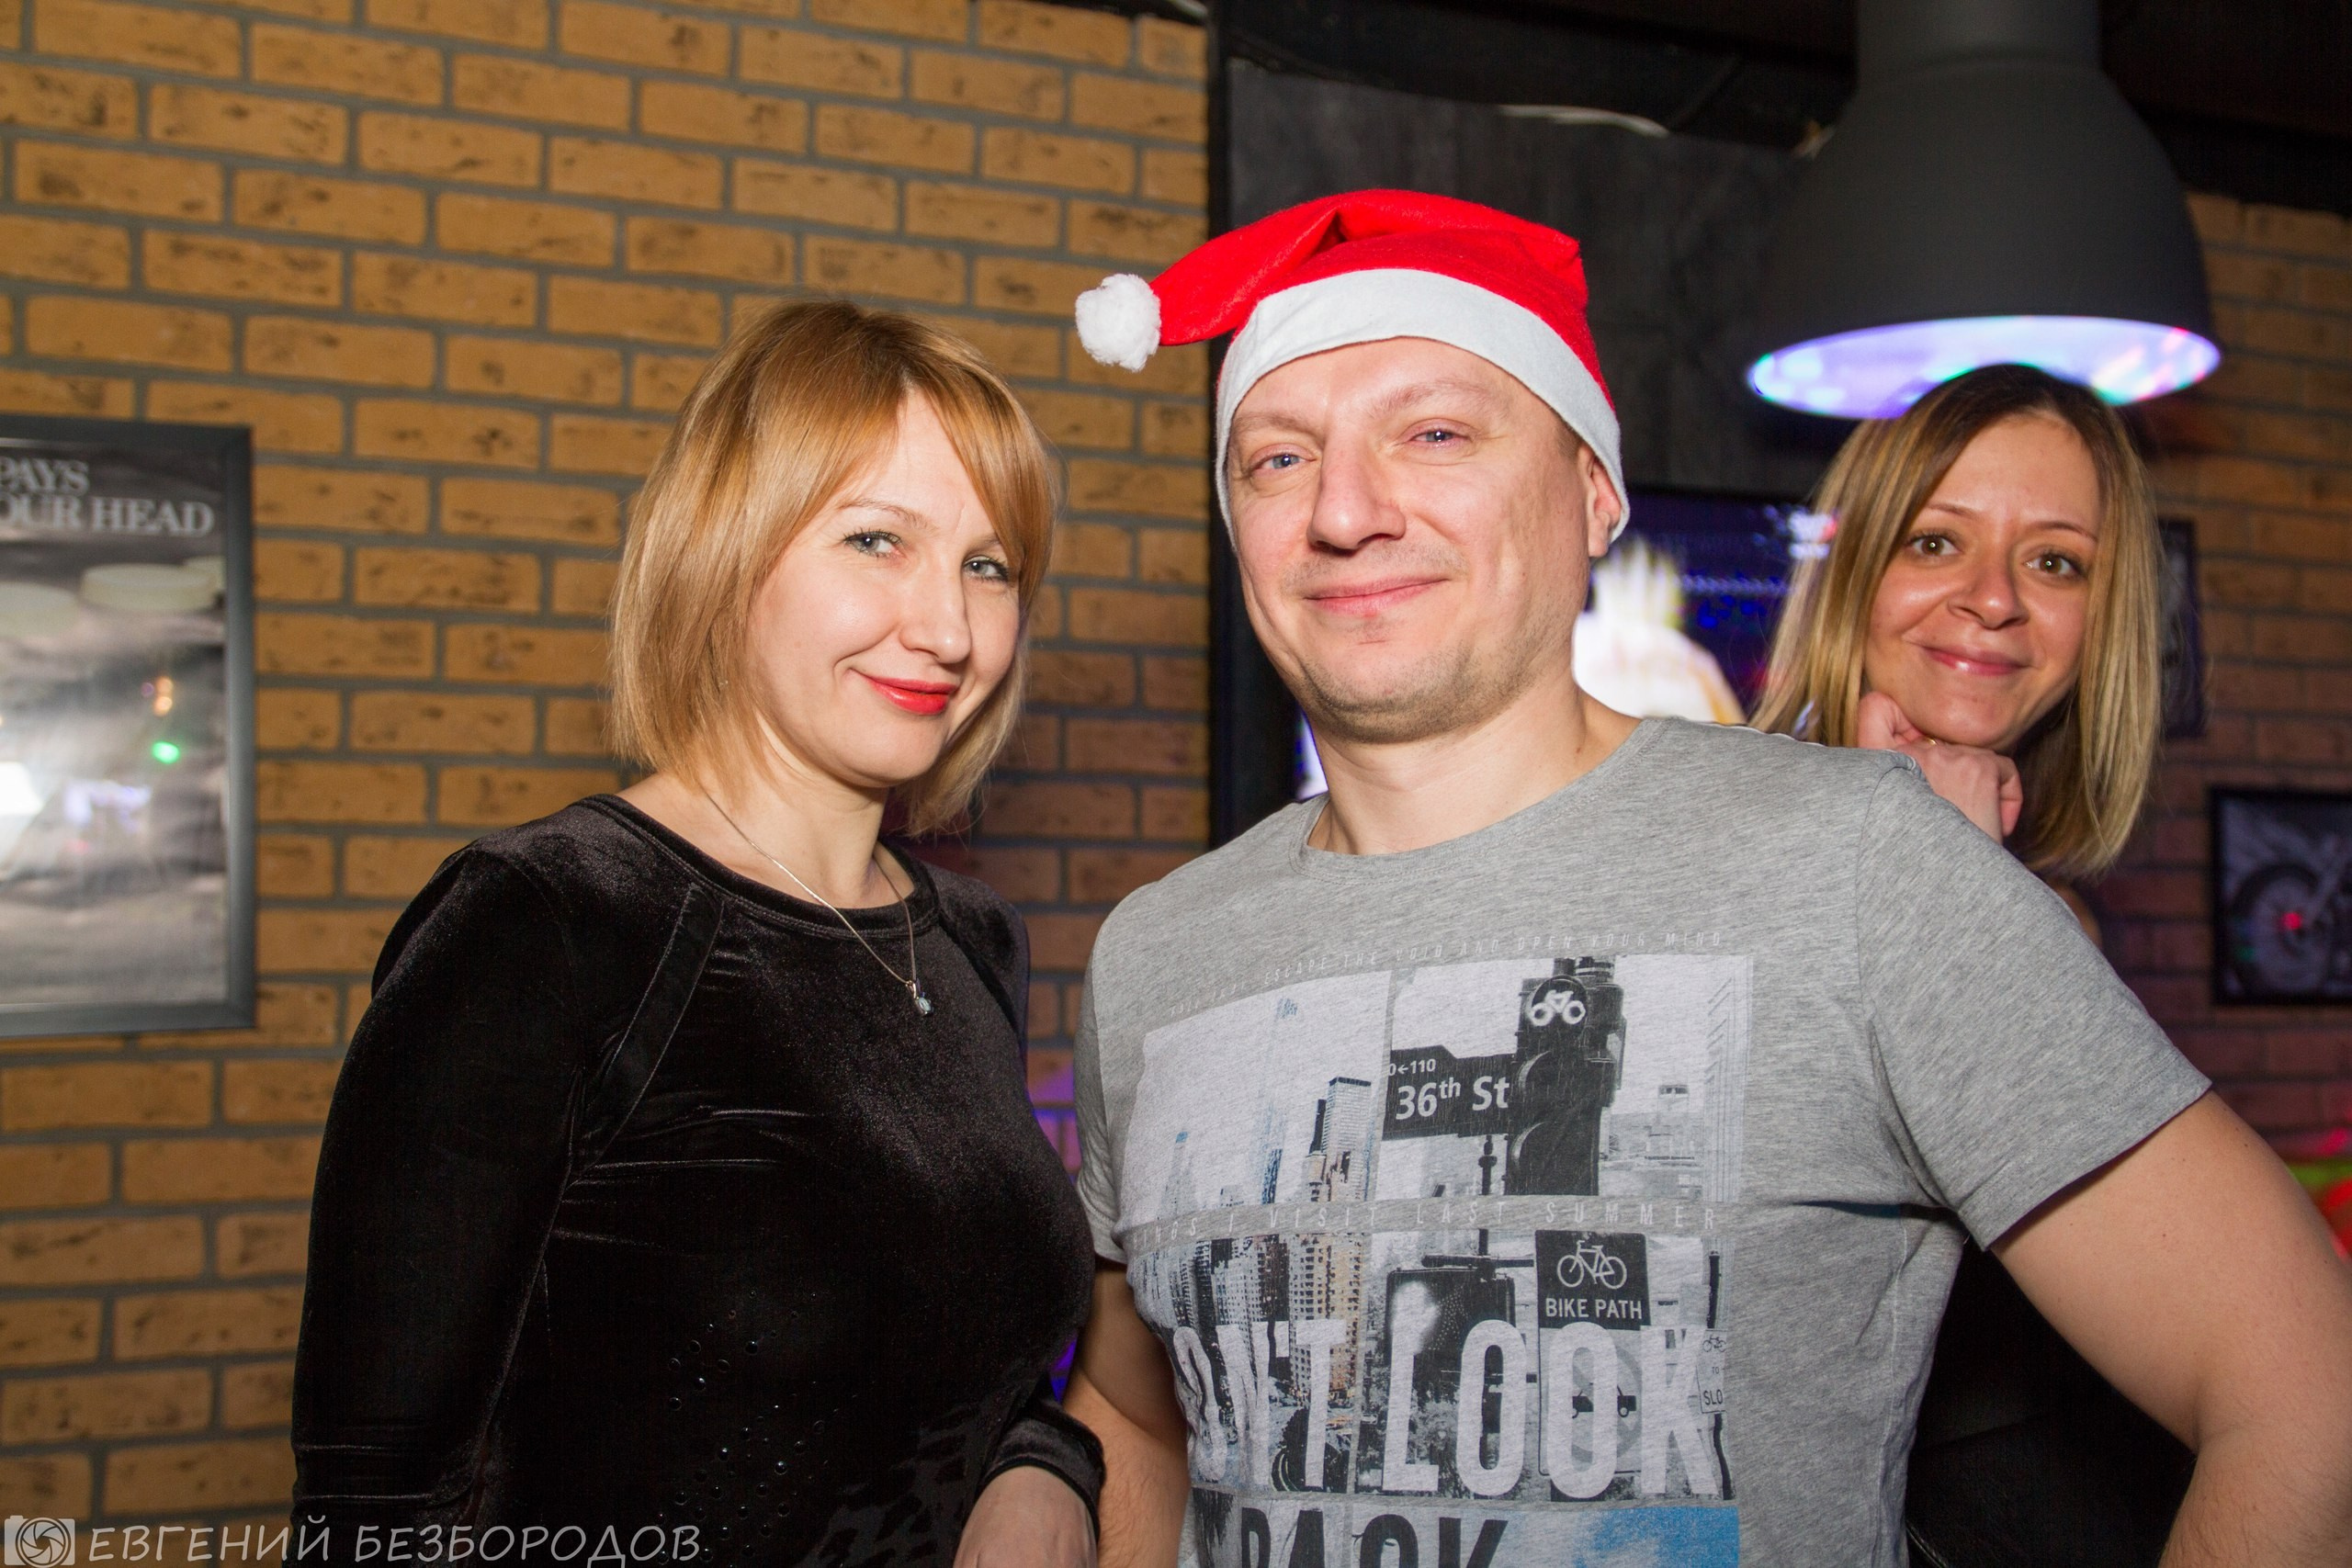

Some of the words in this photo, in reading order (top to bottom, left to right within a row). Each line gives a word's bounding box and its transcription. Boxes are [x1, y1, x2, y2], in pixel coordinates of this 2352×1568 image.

[0, 457, 89, 496] PAYS
[90, 494, 215, 537] HEAD
[1395, 1077, 1462, 1121] 36th
[1472, 1075, 1510, 1111] St
[1270, 1206, 1378, 1230] VISIT
[1417, 1197, 1507, 1224] LAST
[1544, 1197, 1715, 1231] SUMMER
[1545, 1297, 1589, 1319] BIKE
[1594, 1298, 1644, 1321] PATH
